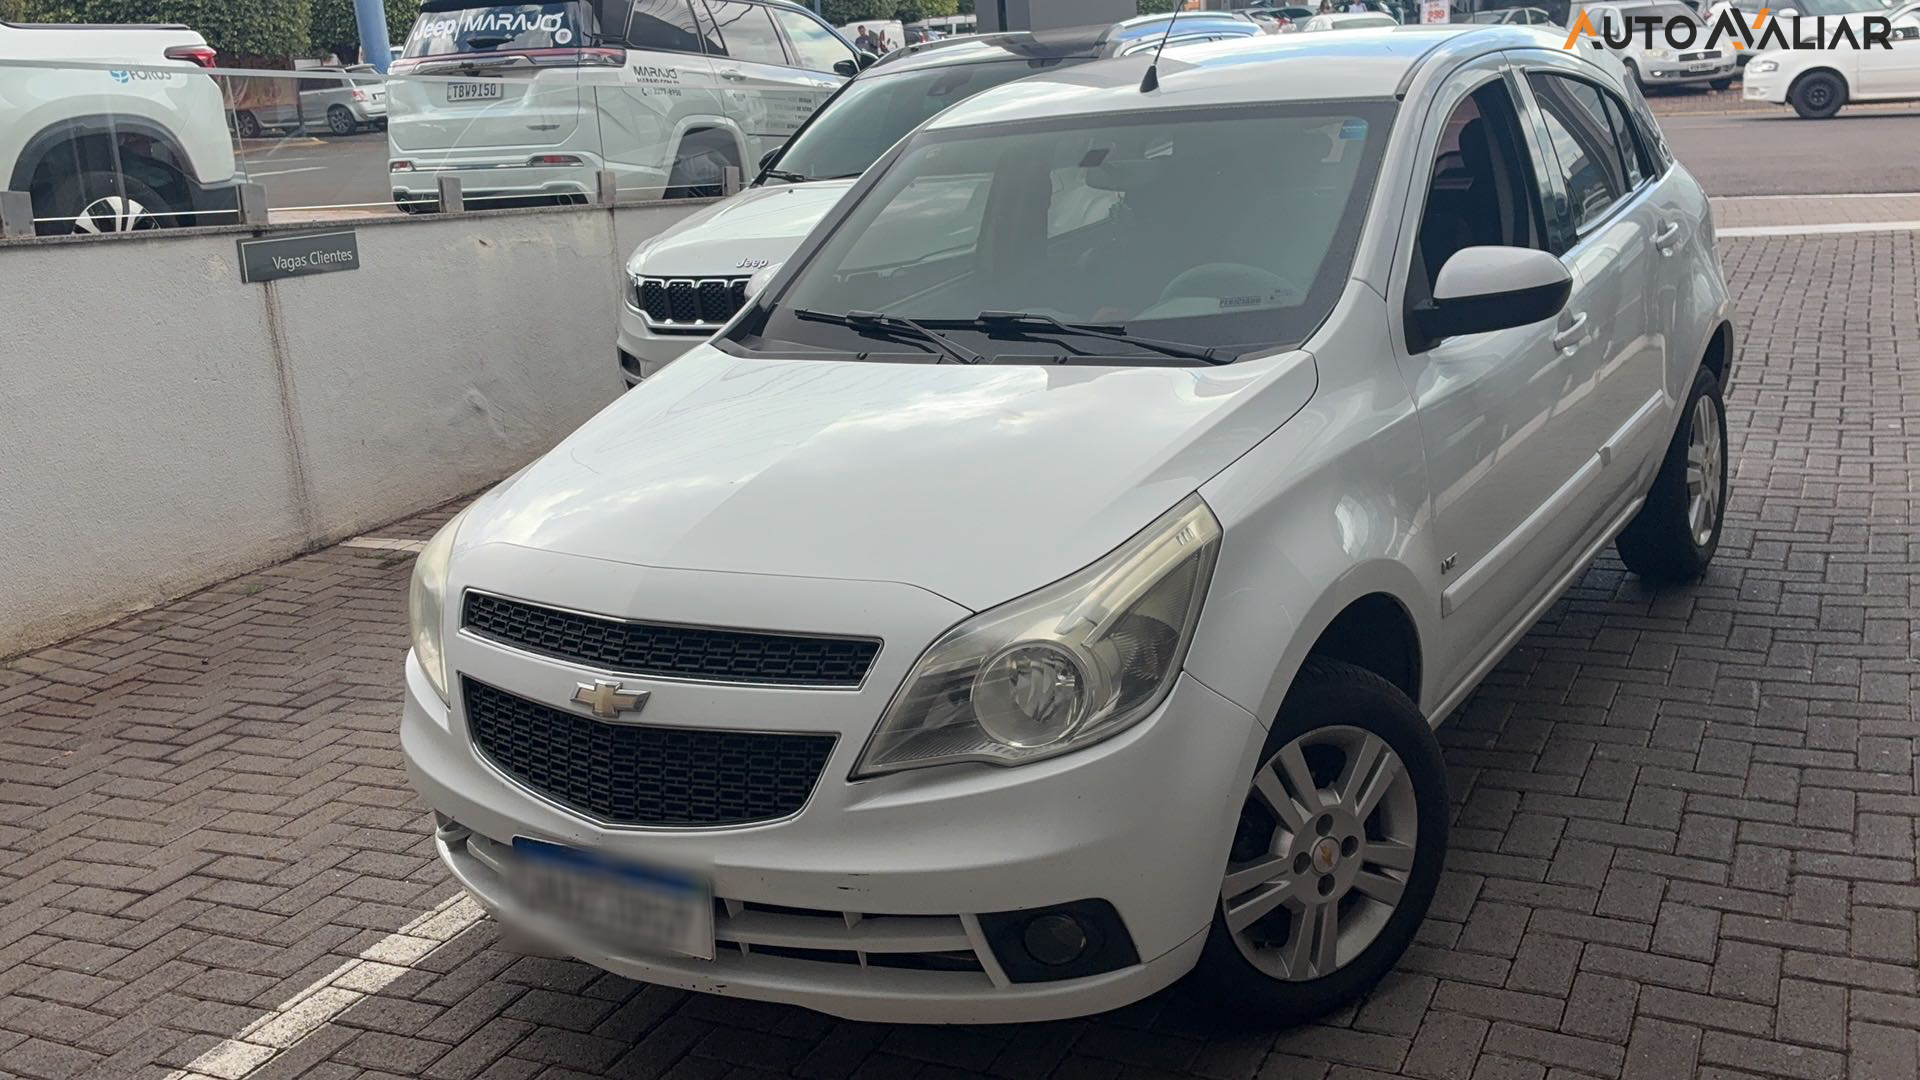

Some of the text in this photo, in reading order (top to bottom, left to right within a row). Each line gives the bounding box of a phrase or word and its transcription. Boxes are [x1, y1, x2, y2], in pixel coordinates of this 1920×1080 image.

[413, 18, 456, 41] Jeep
[272, 250, 354, 272] Vagas Clientes
[736, 257, 769, 270] Jeep
